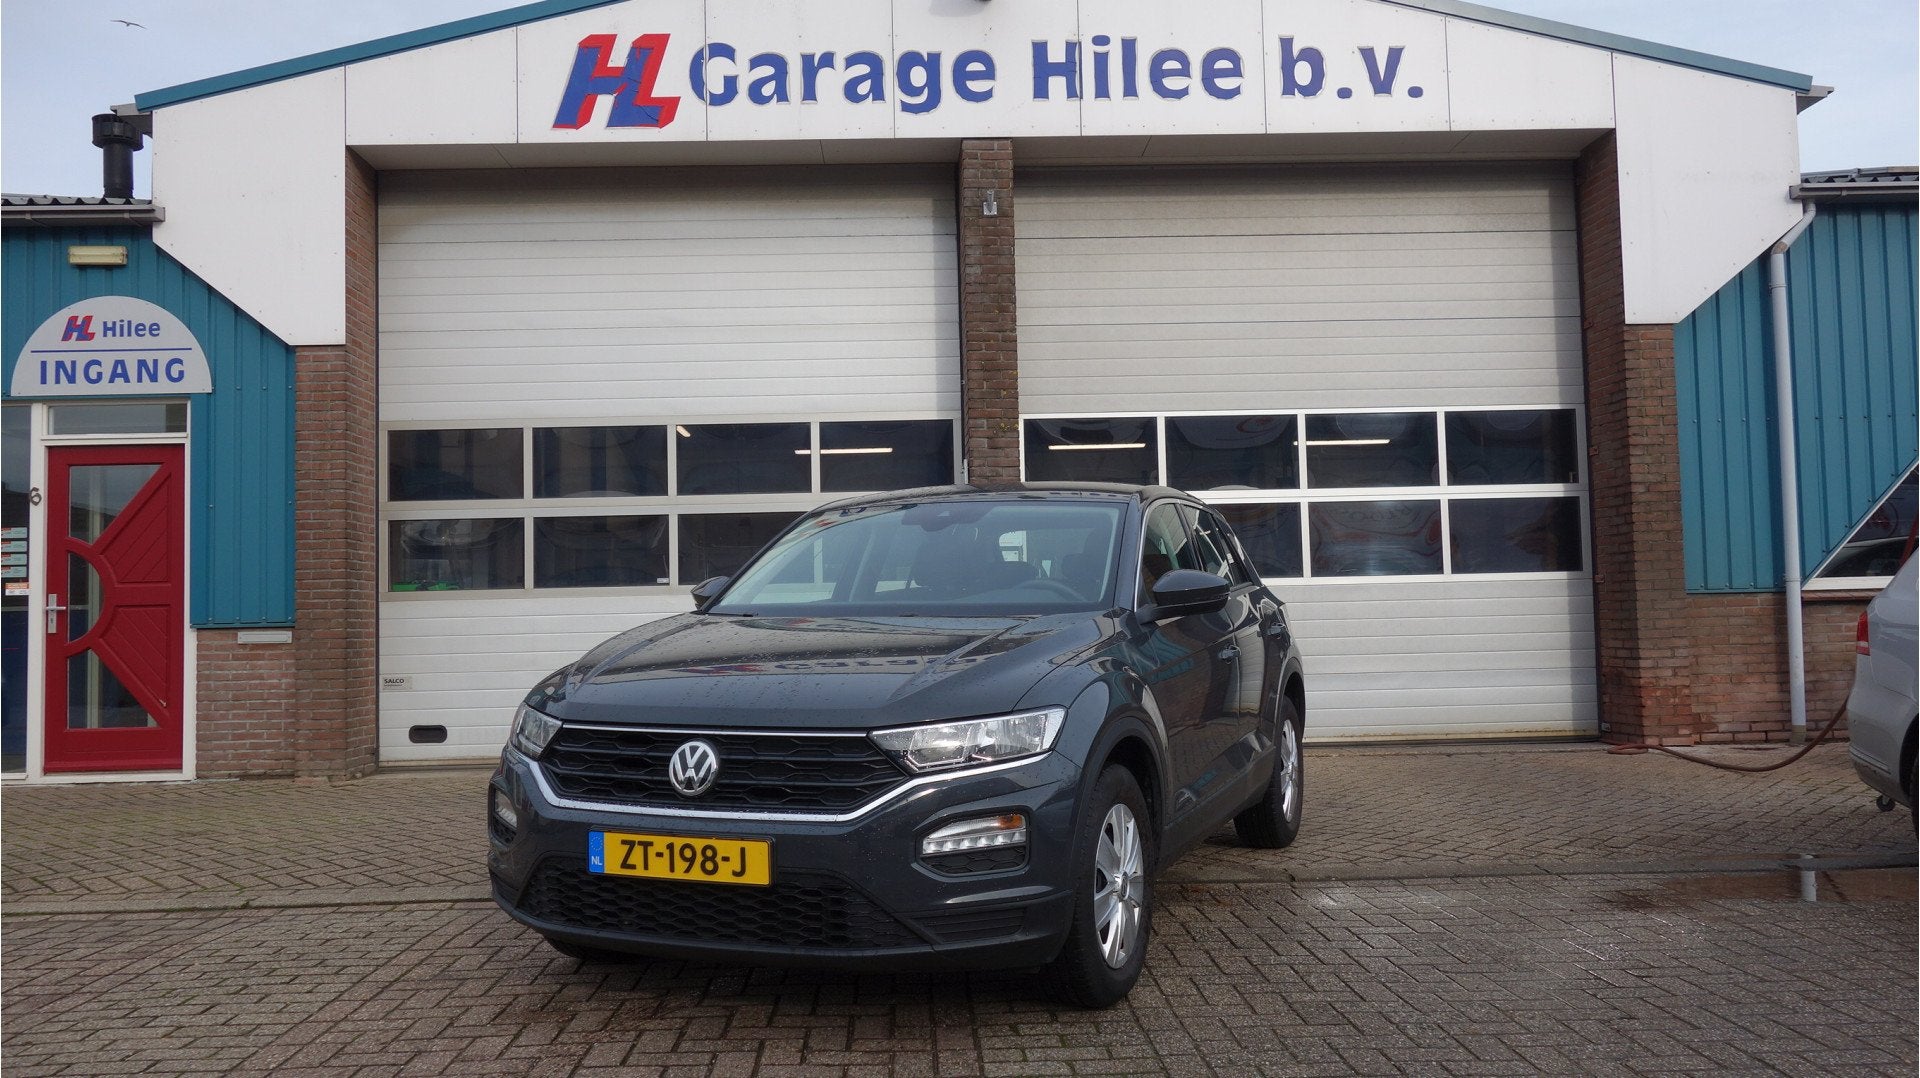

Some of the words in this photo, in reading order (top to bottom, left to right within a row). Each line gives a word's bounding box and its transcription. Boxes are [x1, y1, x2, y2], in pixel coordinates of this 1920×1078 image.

[689, 42, 996, 114] Garage
[1031, 35, 1245, 101] Hilee
[1278, 35, 1424, 99] b.v.
[102, 319, 161, 338] Hilee
[40, 357, 185, 385] INGANG
[29, 487, 42, 506] 6
[591, 855, 603, 866] NL
[620, 839, 746, 878] ZT-198-J
